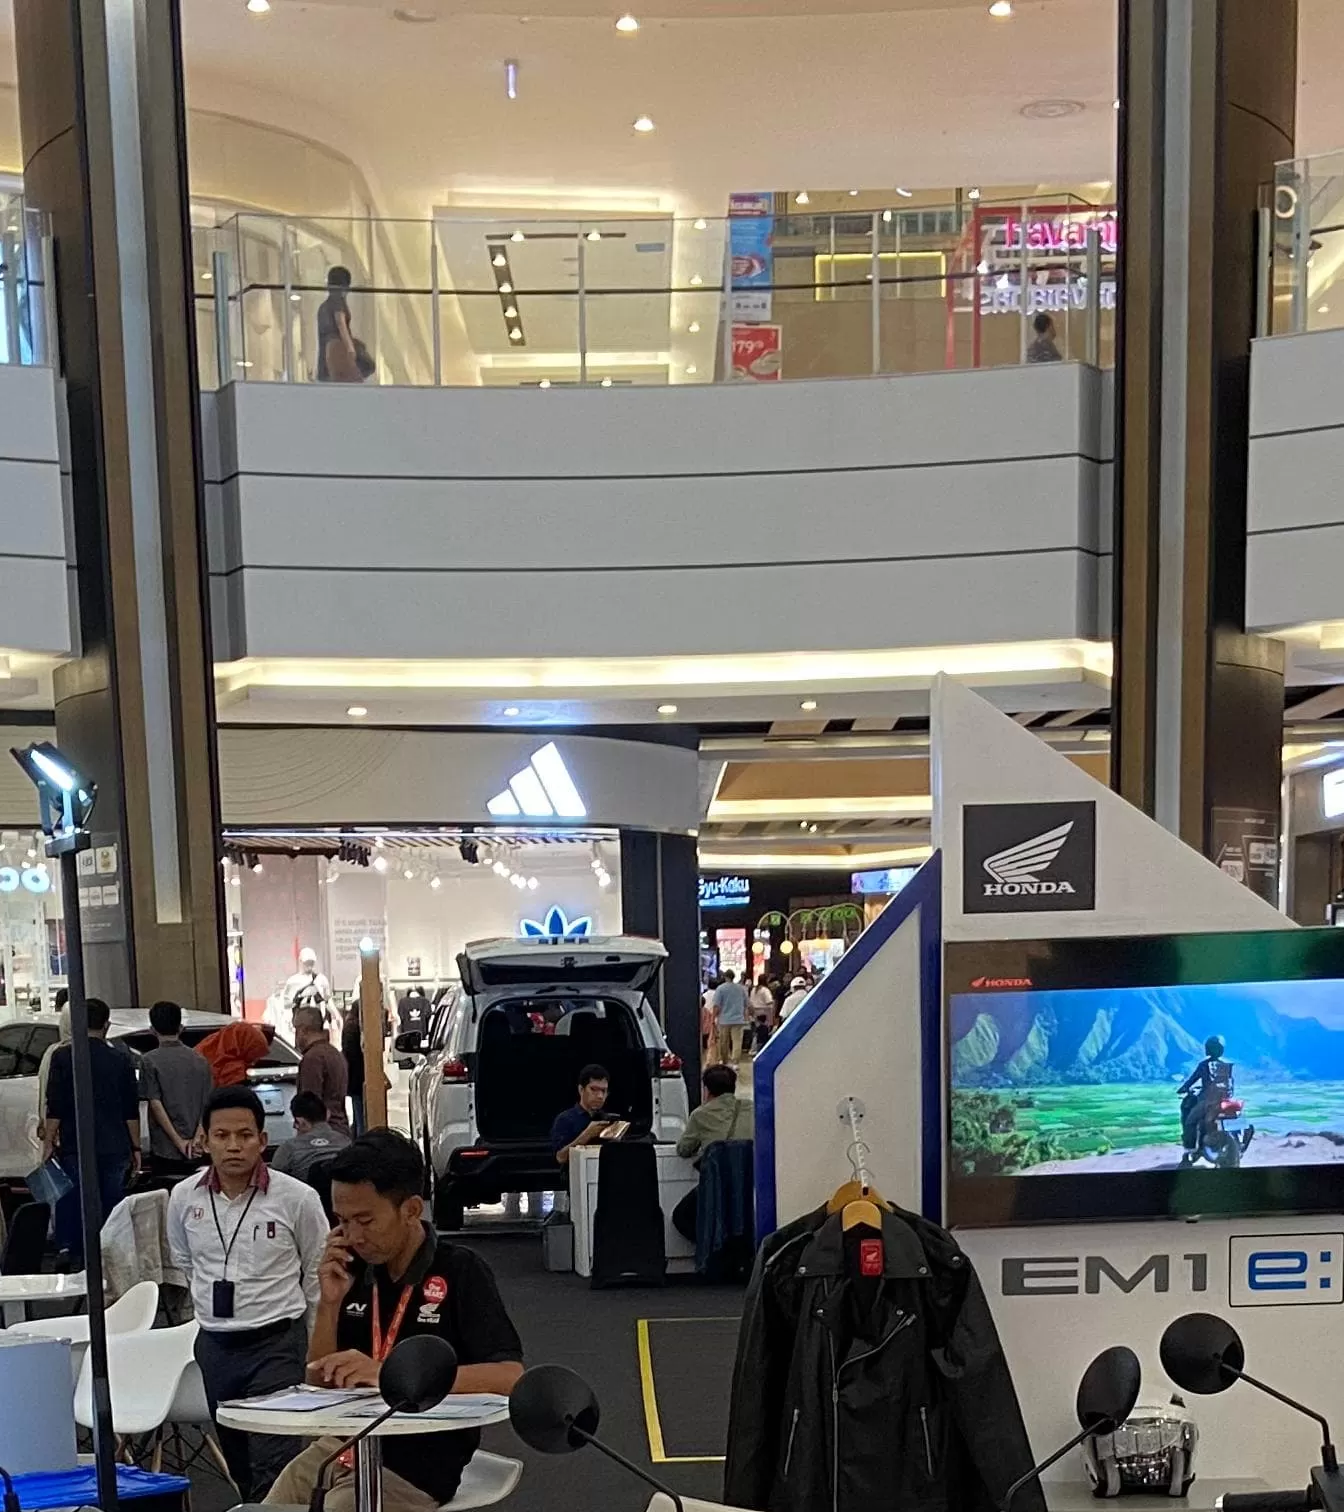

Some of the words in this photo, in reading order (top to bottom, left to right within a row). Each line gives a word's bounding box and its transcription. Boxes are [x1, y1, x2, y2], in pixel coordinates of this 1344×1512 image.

[983, 882, 1075, 895] HONDA
[985, 978, 1033, 988] HONDA
[1002, 1254, 1207, 1295] EM1
[1247, 1251, 1332, 1290] e:
